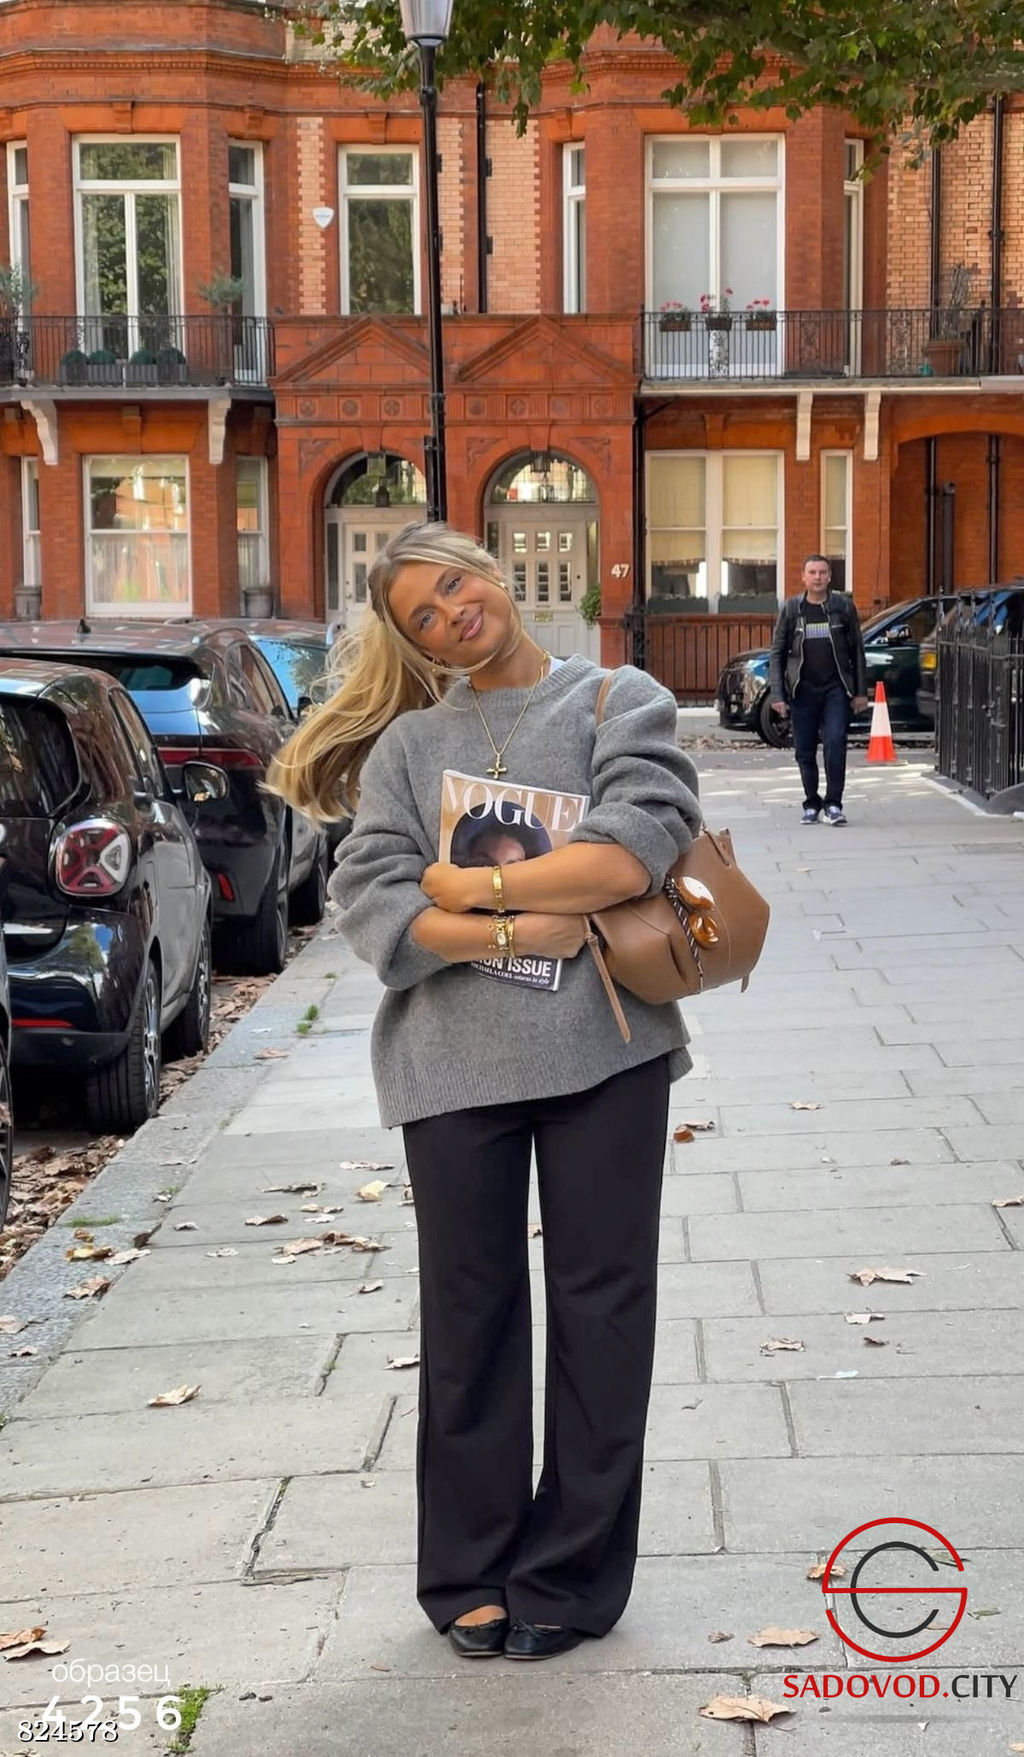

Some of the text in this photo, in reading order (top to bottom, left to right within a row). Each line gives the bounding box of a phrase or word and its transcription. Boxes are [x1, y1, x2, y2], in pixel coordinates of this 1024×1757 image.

[611, 563, 630, 578] 47
[445, 776, 579, 832] VOGUE
[507, 957, 552, 977] ISSUE
